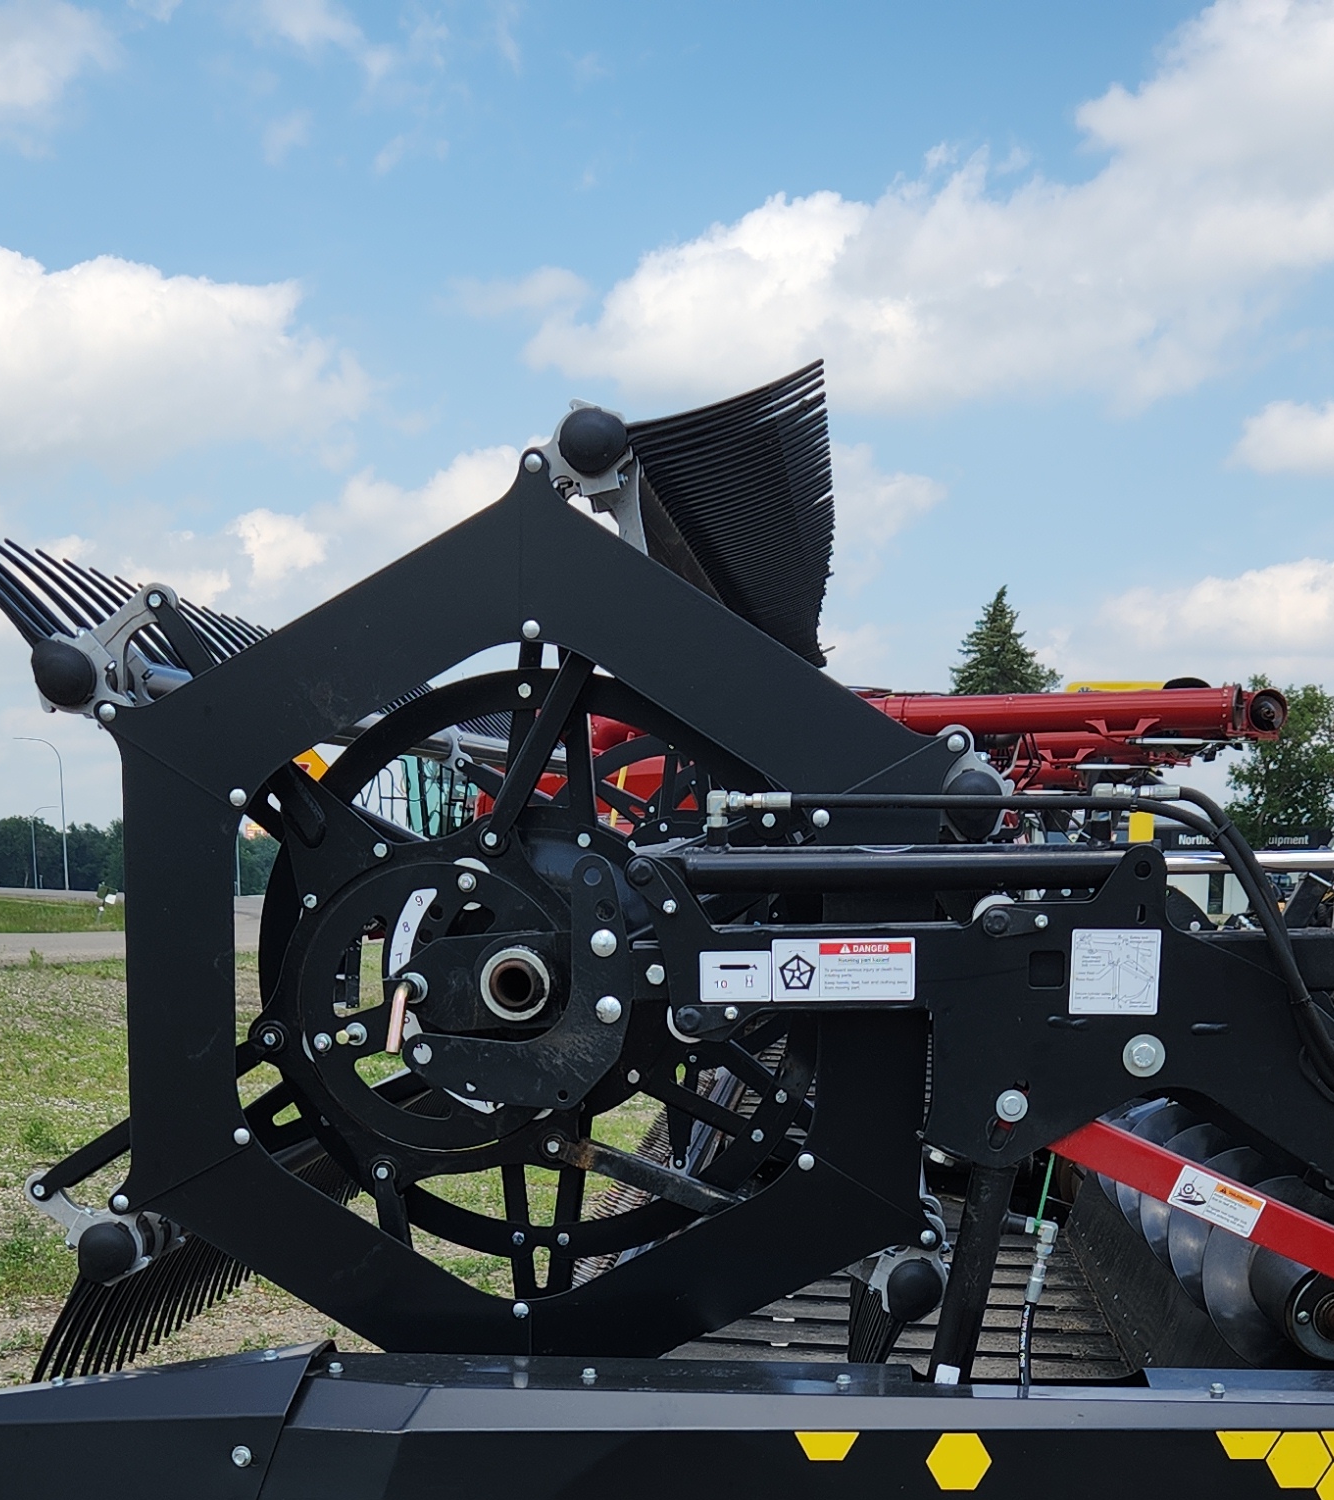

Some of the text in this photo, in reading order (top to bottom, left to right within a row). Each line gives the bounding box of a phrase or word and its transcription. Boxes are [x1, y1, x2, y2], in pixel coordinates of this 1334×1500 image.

[1268, 834, 1309, 847] uipment
[415, 895, 424, 906] 9
[402, 921, 410, 933] 8
[852, 944, 889, 953] DANGER
[395, 953, 404, 964] 7
[714, 980, 728, 988] 10
